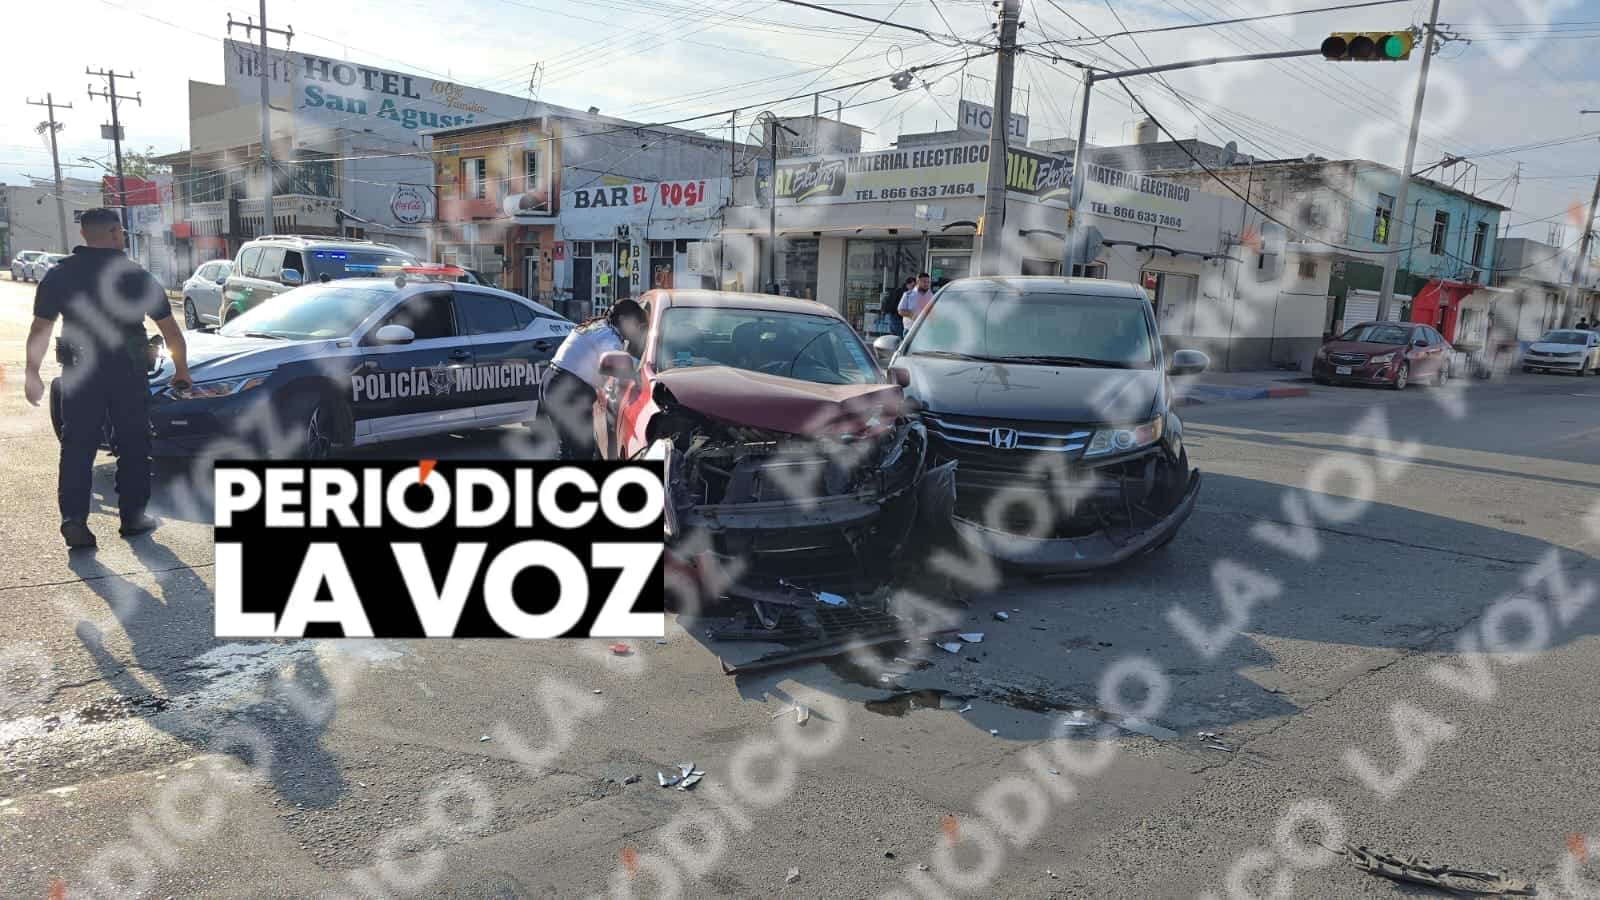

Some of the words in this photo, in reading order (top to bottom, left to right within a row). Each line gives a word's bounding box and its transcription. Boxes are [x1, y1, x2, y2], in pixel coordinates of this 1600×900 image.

[303, 56, 420, 99] HOTEL
[304, 85, 368, 115] San
[965, 103, 1026, 138] HOEL
[848, 152, 909, 174] MATERIAL
[912, 144, 990, 169] ELECTRICO
[574, 187, 629, 208] BAR
[633, 186, 648, 203] EL
[856, 190, 878, 201] TEL.
[880, 188, 907, 200] 866
[910, 186, 937, 198] 633
[940, 183, 975, 195] 7464
[1088, 164, 1140, 192] MATERIAL
[1141, 178, 1190, 202] ELECTRICO
[1113, 206, 1135, 219] 866
[1137, 211, 1157, 223] 633
[1159, 214, 1182, 228] 7464
[632, 246, 641, 286] BAR
[351, 366, 431, 402] POLICÍA
[455, 362, 545, 393] MUNICIPAL
